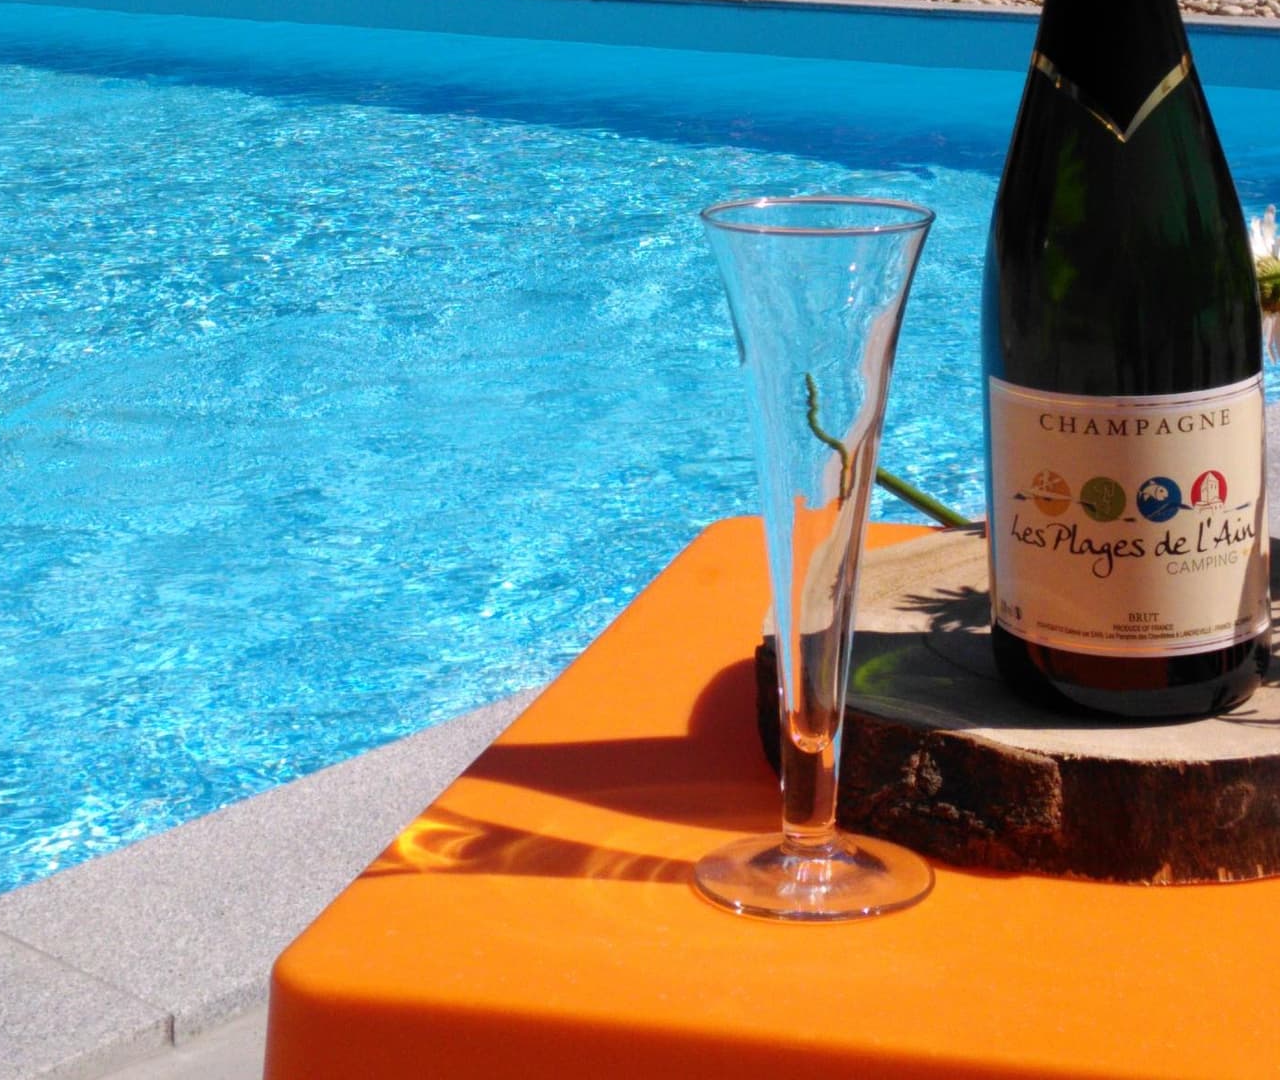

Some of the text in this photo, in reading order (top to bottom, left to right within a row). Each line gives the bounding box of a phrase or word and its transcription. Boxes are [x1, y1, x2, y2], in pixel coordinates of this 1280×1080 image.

[1039, 408, 1231, 436] CHAMPAGNE
[1010, 514, 1256, 578] Les Plages de l'Ain
[1166, 553, 1239, 576] CAMPING
[1128, 611, 1160, 622] BRUT
